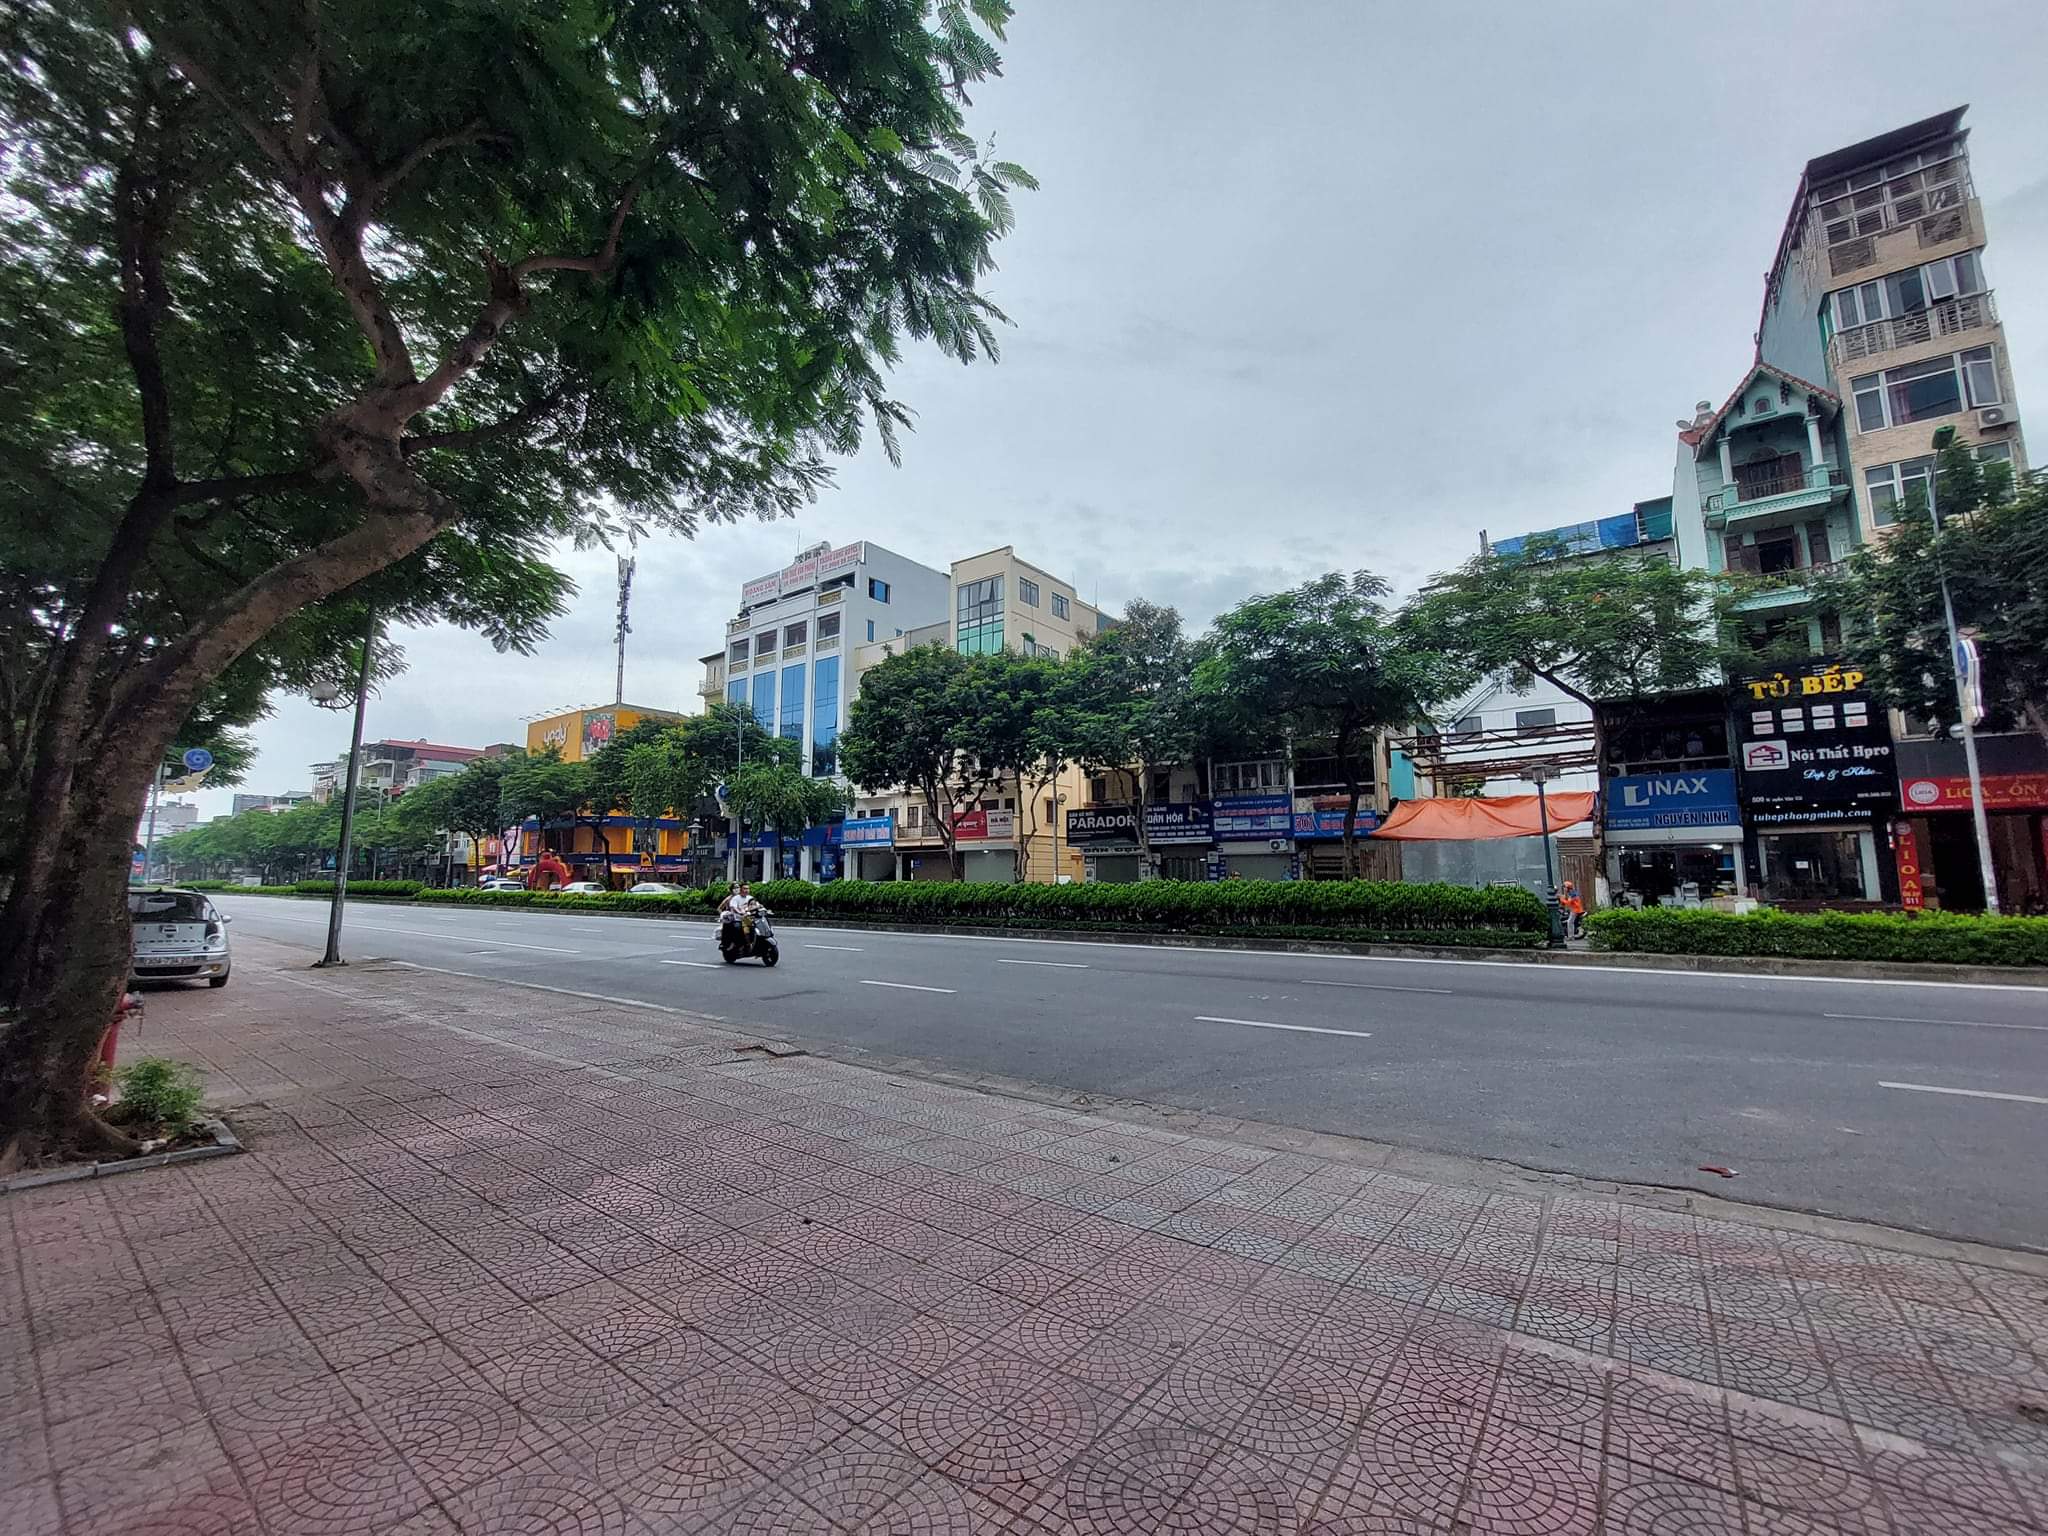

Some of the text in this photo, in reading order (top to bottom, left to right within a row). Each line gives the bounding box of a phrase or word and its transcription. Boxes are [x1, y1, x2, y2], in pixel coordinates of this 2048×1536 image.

[1748, 664, 1864, 700] TỦ BẾP
[1790, 750, 1814, 764] Nội
[1816, 744, 1848, 760] Thất
[1852, 746, 1890, 759] Hpro
[1068, 814, 1136, 830] PARADOR
[1700, 811, 1729, 824] NINH
[1753, 810, 1872, 822] tubepthongminh.com
